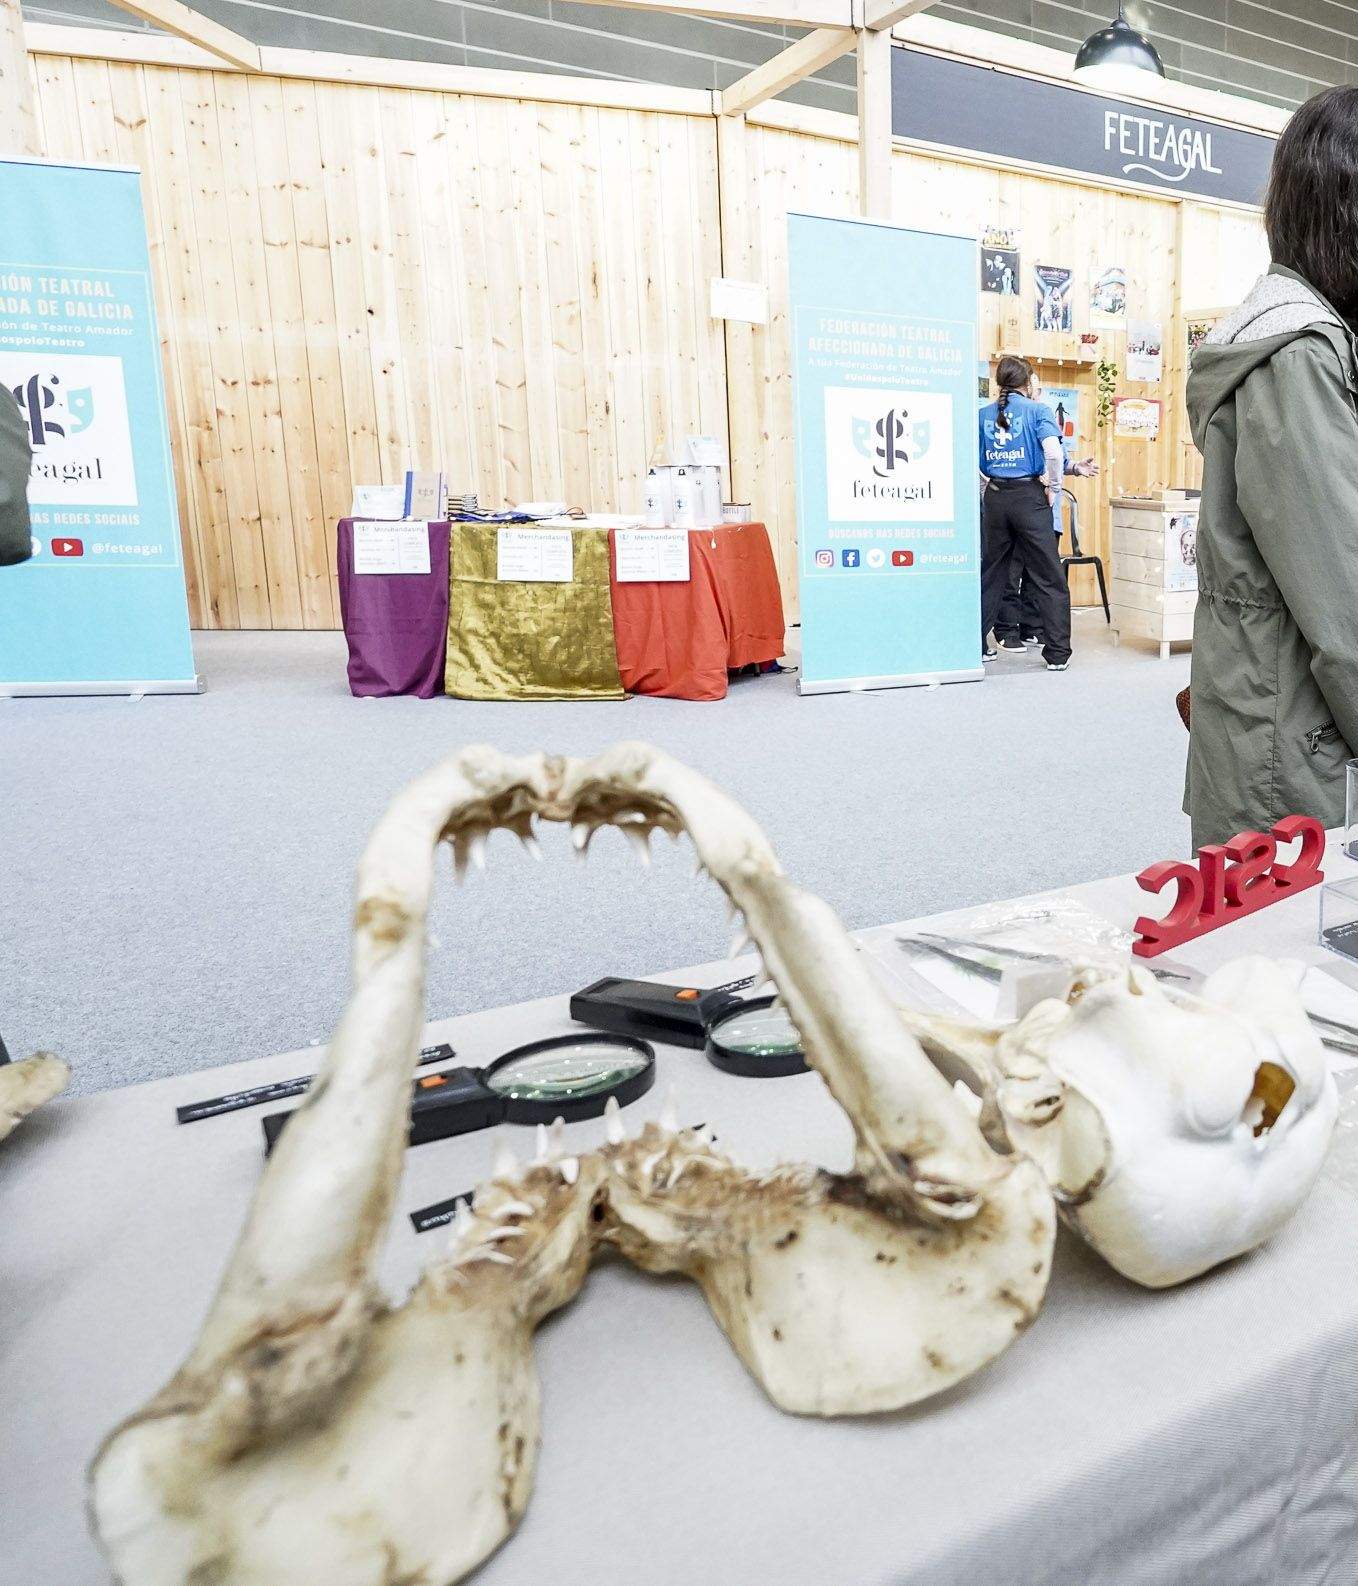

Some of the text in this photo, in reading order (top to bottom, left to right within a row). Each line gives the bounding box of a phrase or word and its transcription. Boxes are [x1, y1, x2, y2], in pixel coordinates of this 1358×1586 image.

[1103, 110, 1223, 178] FETEAGAL
[39, 277, 115, 298] TEATRAL
[37, 299, 59, 316] DE
[65, 301, 134, 320] GALICIA
[22, 322, 37, 331] de
[41, 322, 82, 333] Teatro
[85, 325, 135, 335] Amador
[818, 318, 952, 344] FEDERACIÓN TEATRAL
[808, 337, 963, 363] AFECCIONADA DE GALICIA
[853, 480, 932, 503] feteagal
[54, 513, 90, 525] REDES
[95, 513, 140, 526] SOCIAIS
[91, 542, 163, 556] @feteagal
[919, 553, 968, 566] @feteagal
